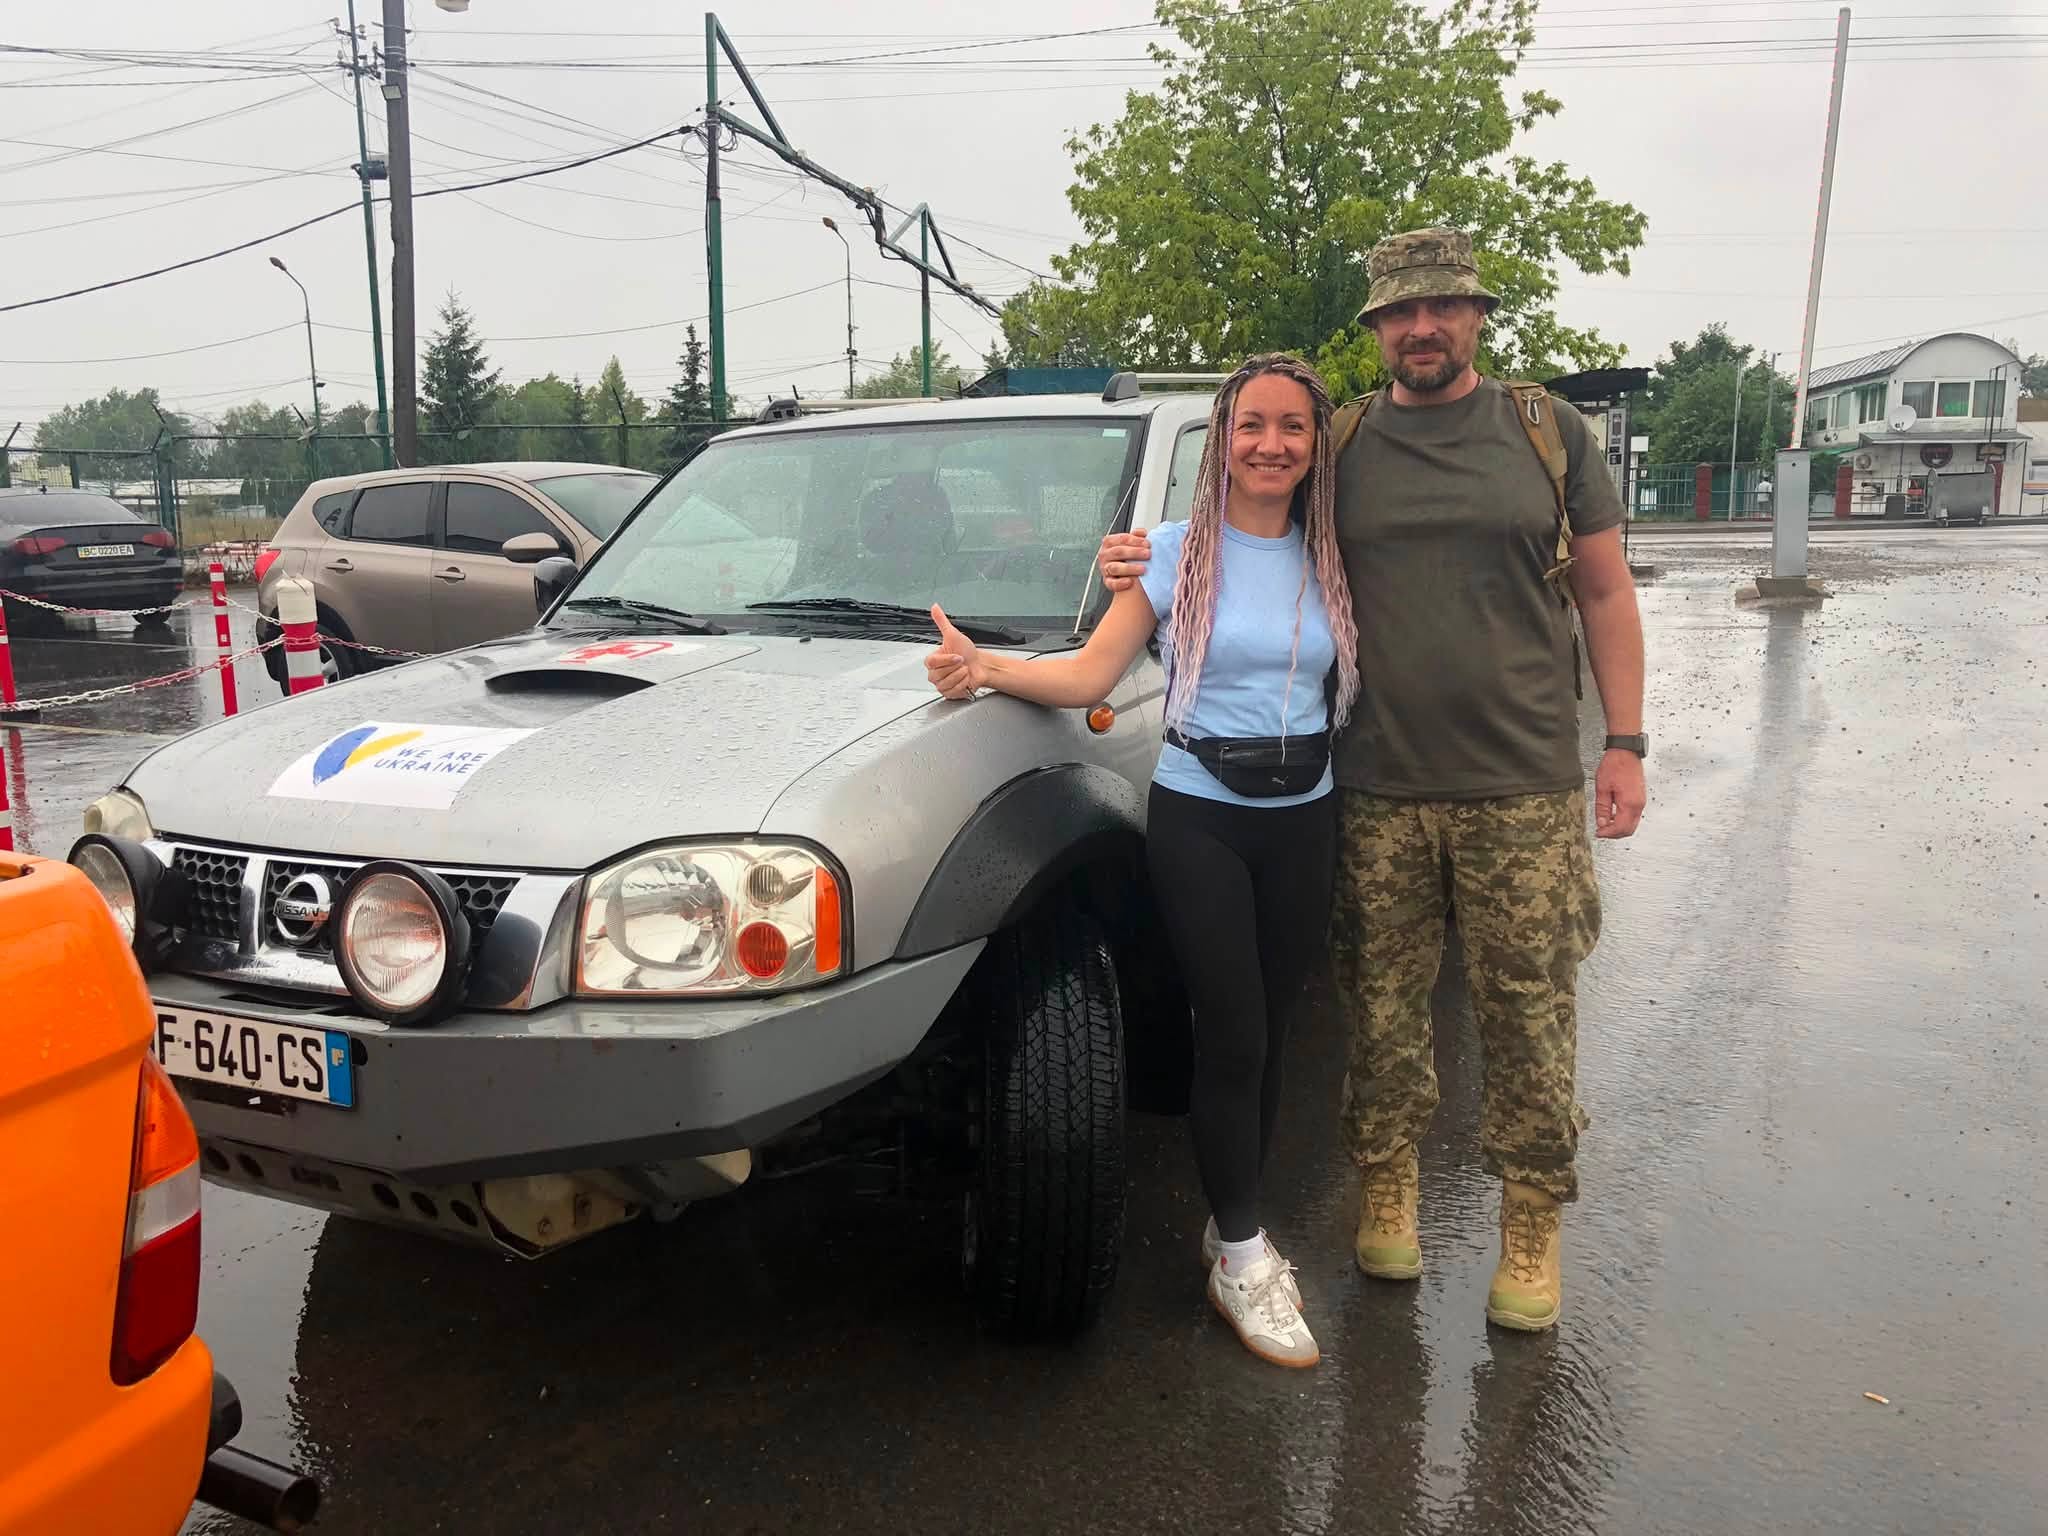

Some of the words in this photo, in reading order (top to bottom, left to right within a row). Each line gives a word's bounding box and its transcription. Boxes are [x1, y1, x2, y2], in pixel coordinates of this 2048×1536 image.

[397, 748, 433, 758] WE
[439, 751, 488, 762] ARE
[374, 757, 473, 774] UKRAINE
[152, 1013, 324, 1093] F-640-CS
